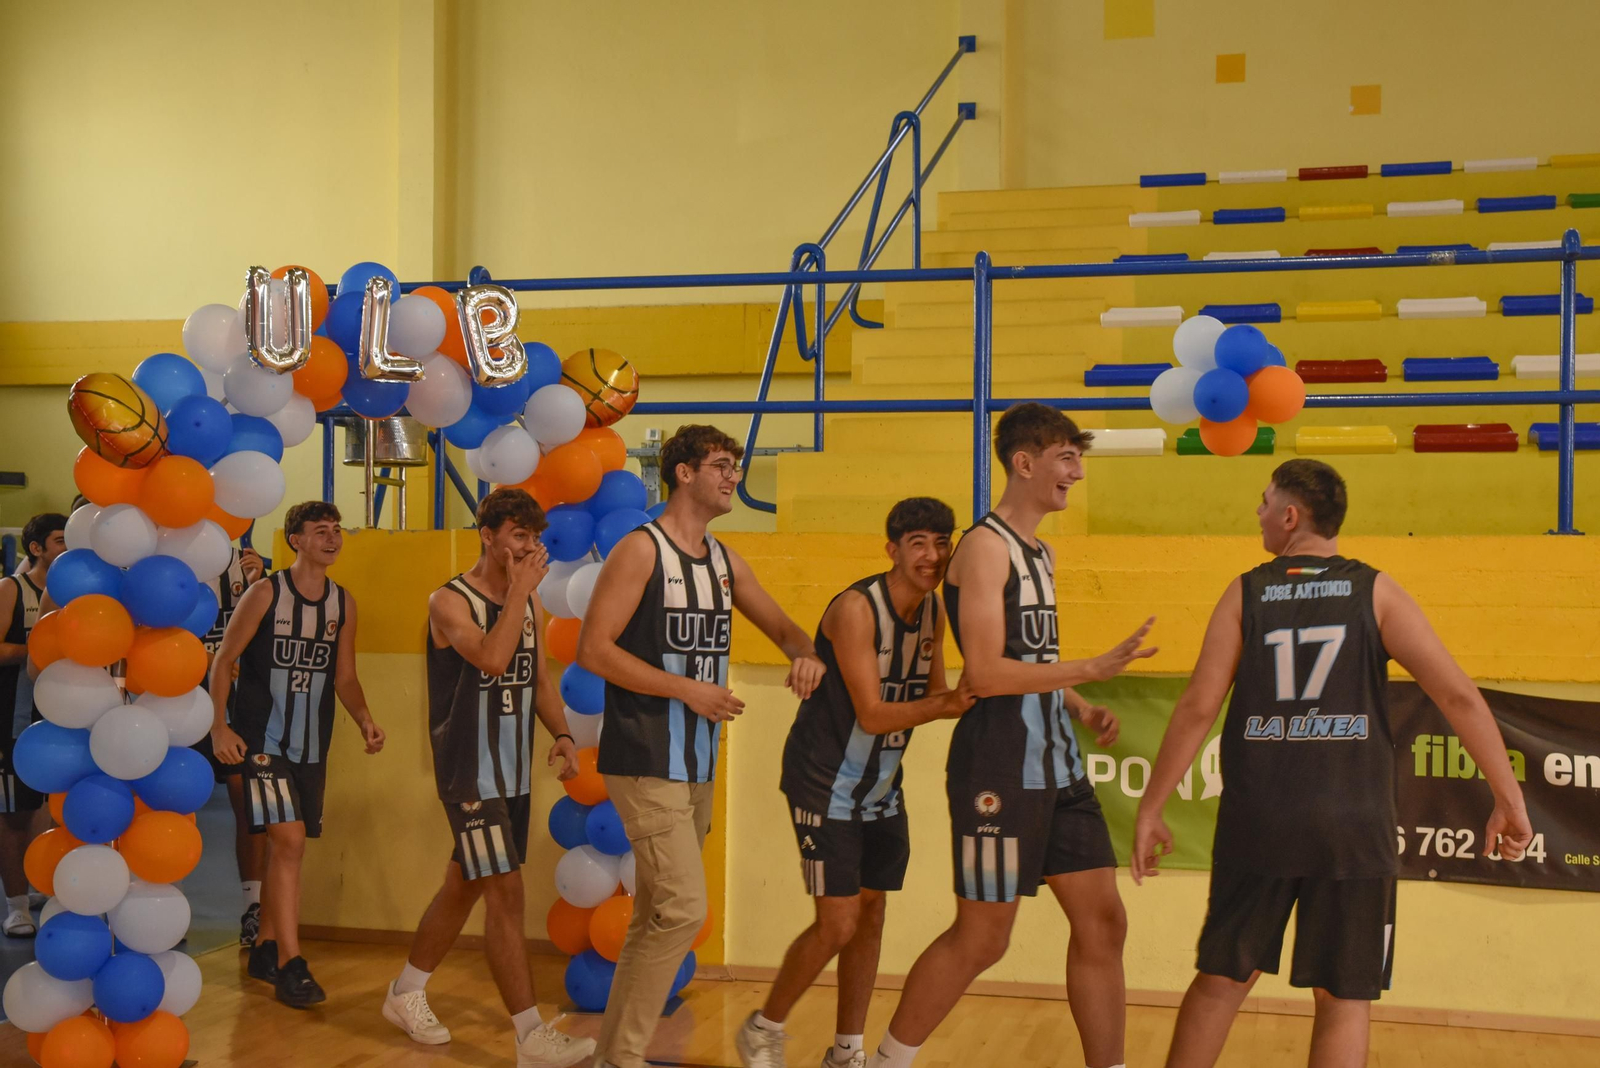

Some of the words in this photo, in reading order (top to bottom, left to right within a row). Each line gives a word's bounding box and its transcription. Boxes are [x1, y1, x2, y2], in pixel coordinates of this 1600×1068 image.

[1261, 583, 1293, 602] JOSE
[1293, 579, 1353, 600] ANTONIO
[276, 617, 291, 626] vive
[666, 612, 731, 651] ULB
[273, 638, 331, 669] ULB
[1264, 624, 1347, 702] 17
[291, 670, 311, 693] 22
[694, 655, 714, 683] 30
[502, 688, 514, 713] 9
[1244, 715, 1285, 741] LA
[1286, 707, 1369, 741] LÍNEA
[1411, 734, 1526, 782] fiba
[257, 771, 274, 779] vive
[465, 818, 485, 828] vive
[976, 822, 1001, 834] vive
[1415, 826, 1475, 859] 762
[1565, 853, 1591, 866] Calle
